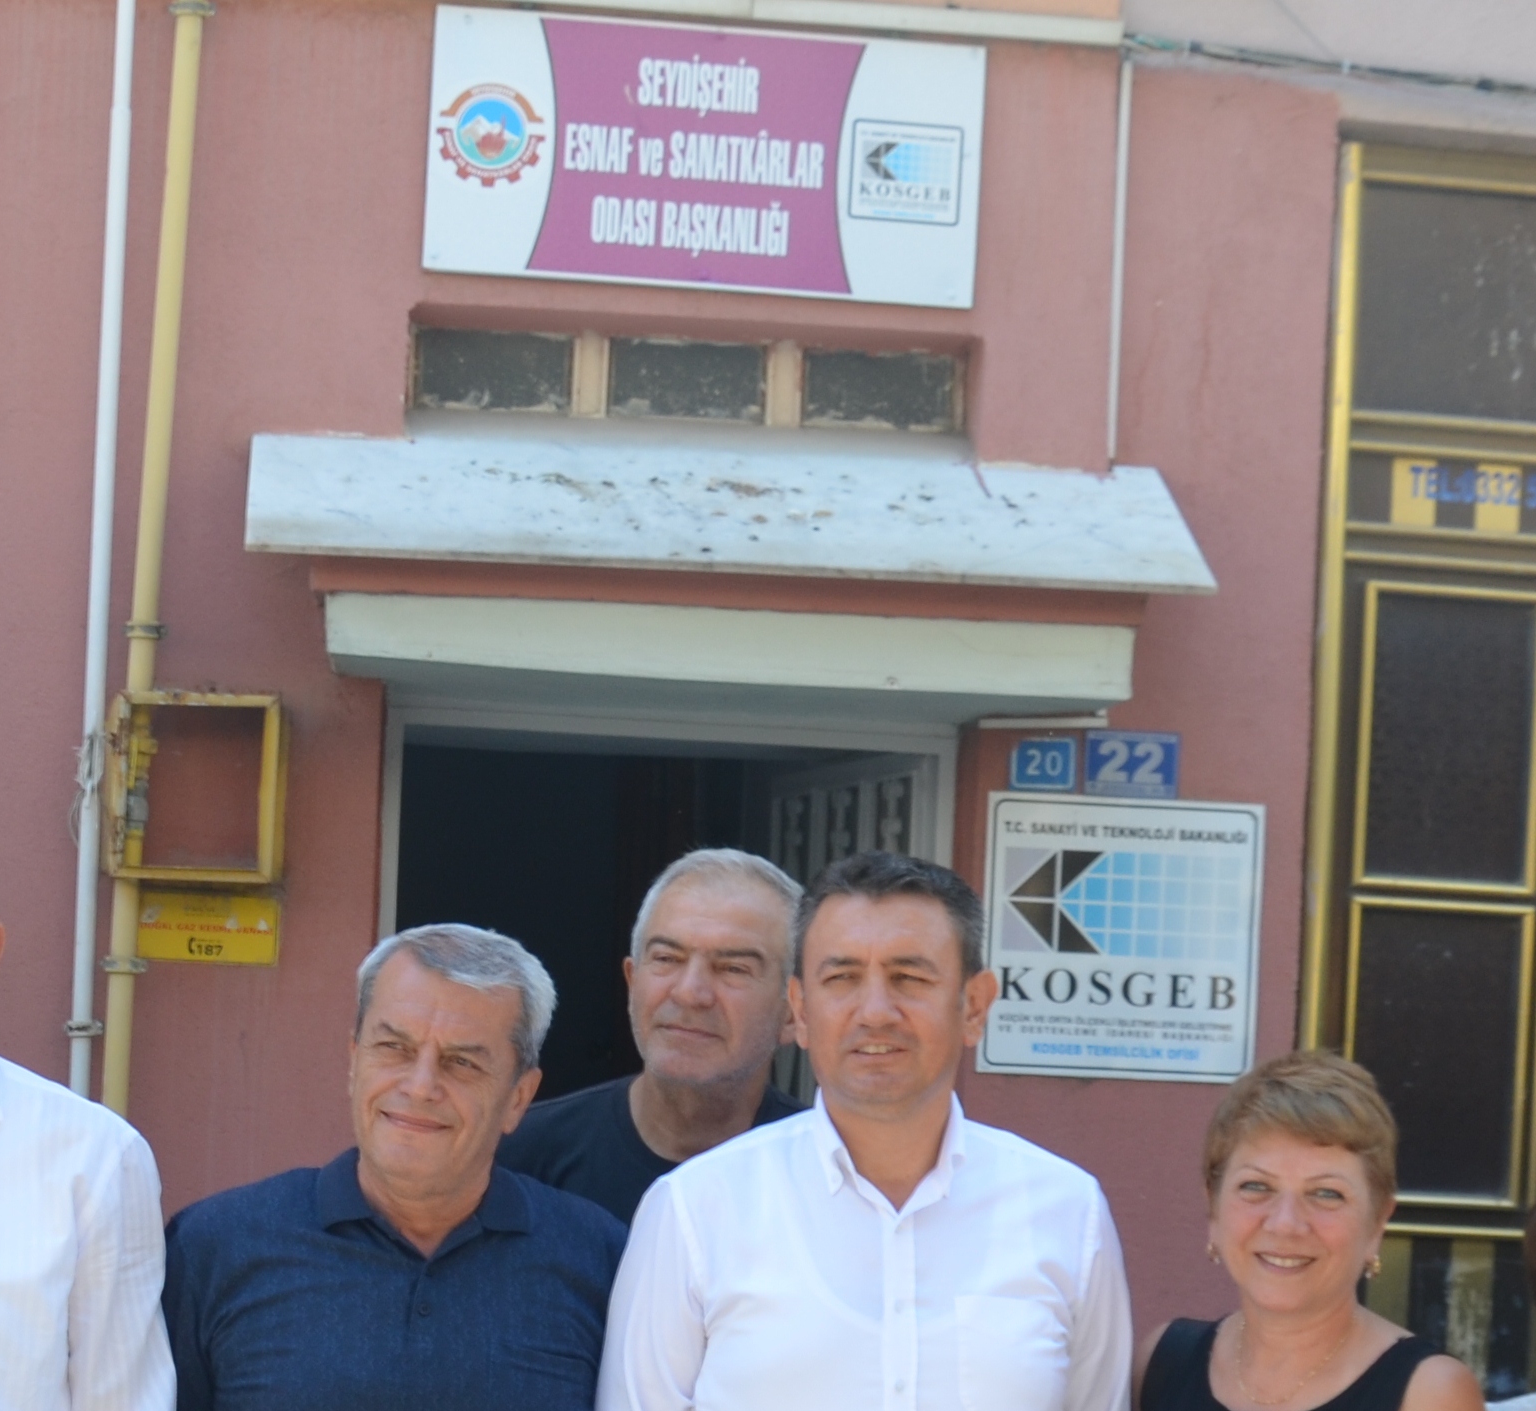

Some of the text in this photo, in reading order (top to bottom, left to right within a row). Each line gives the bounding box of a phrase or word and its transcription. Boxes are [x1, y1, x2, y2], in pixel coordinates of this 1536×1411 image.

[638, 54, 760, 118] SEYDİŞEHİR
[563, 122, 635, 174] ESNAF
[638, 137, 664, 177] ve
[668, 129, 825, 189] SANATKÂRLAR
[590, 195, 789, 258] ODASI BAŞKANLIĞI
[1026, 748, 1063, 777] 20
[1095, 740, 1164, 784] 22
[1082, 825, 1097, 837] VE
[196, 944, 224, 957] 187
[999, 966, 1237, 1011] KOSGEB
